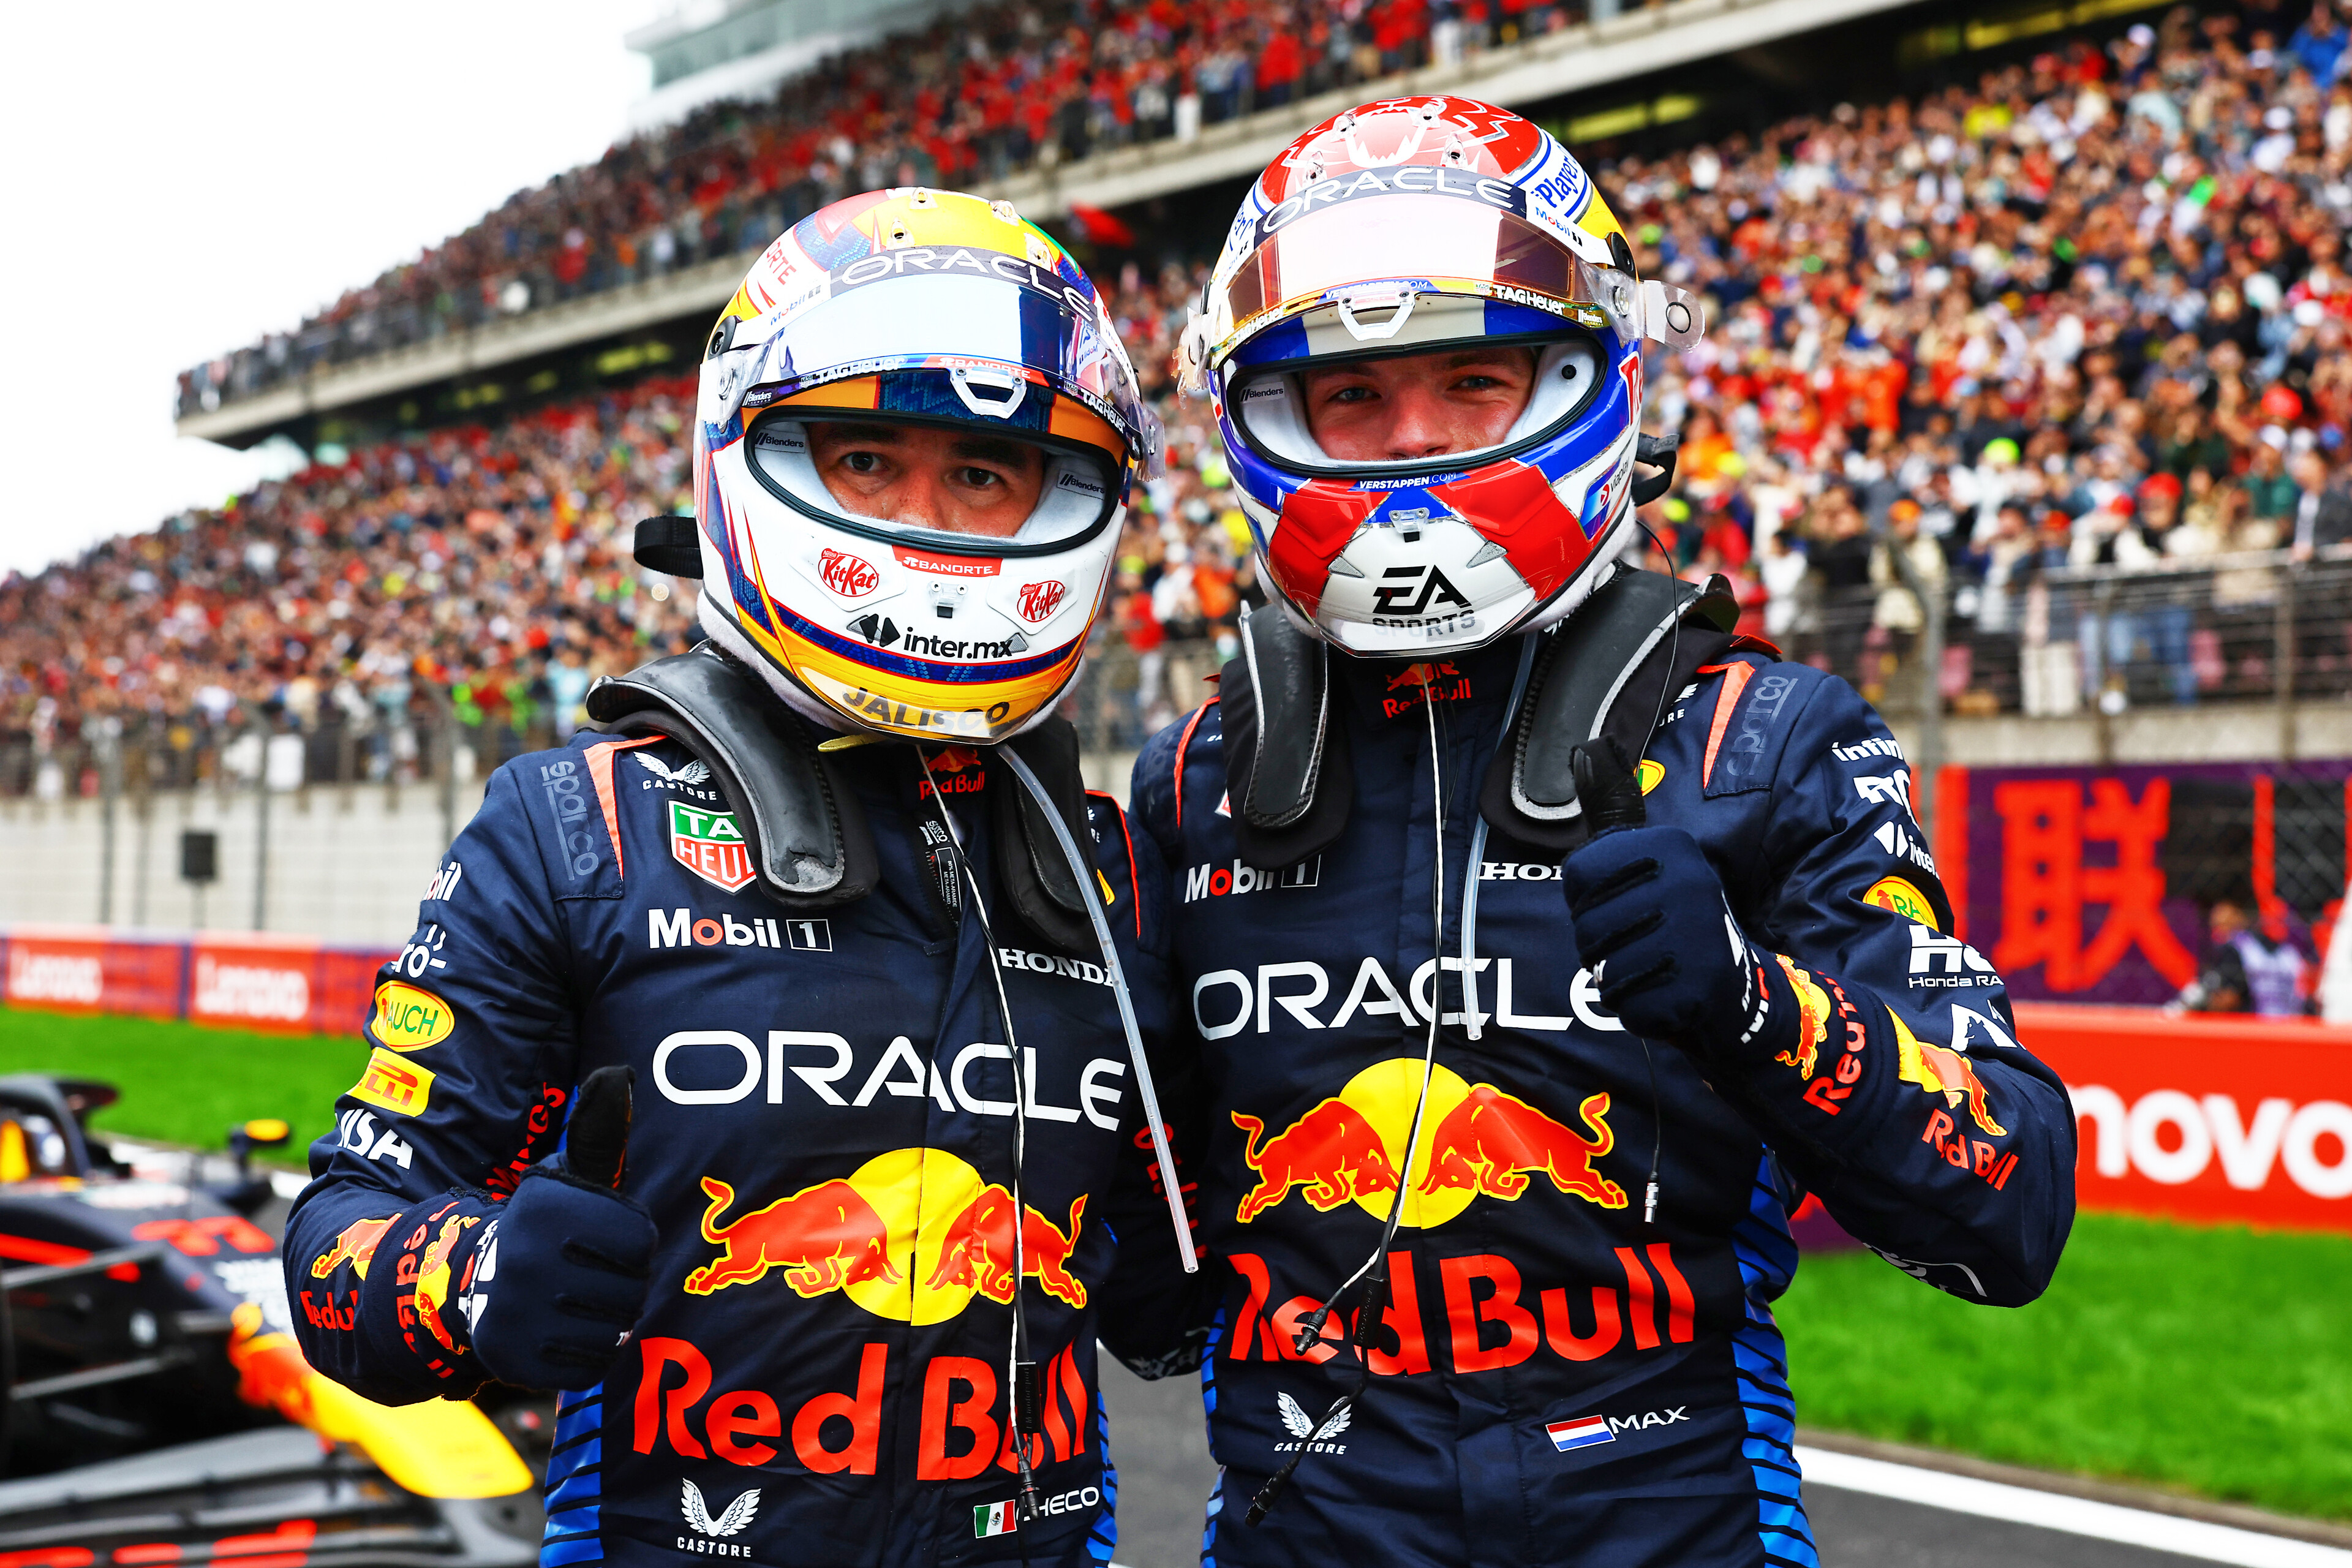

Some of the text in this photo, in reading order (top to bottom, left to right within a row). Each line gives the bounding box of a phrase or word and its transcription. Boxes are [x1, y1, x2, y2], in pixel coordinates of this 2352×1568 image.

[1263, 167, 1514, 233] ORACLE
[1536, 206, 1570, 236] Mobil
[766, 241, 797, 285] ORTE
[842, 248, 1094, 322] ORACLE
[771, 294, 805, 326] Mobil
[748, 391, 772, 403] Blenders
[1250, 388, 1284, 398] Blenders
[766, 435, 804, 448] Blenders
[1071, 478, 1106, 494] Blenders
[1359, 472, 1457, 489] VERSTAPPEN.COM
[1610, 456, 1630, 493] viaplay
[919, 560, 993, 575] BANORTE
[1372, 564, 1472, 616] EA
[1372, 609, 1476, 637] SPORTS
[903, 627, 1013, 659] inter.mx
[842, 687, 1011, 735] JALISCO
[1726, 676, 1790, 777] sparco
[1831, 737, 1904, 762] infin
[642, 778, 717, 801] CASTORE
[954, 771, 986, 794] Bull
[543, 760, 600, 876] sparco
[679, 809, 742, 839] TA
[1992, 778, 2199, 993] 联
[648, 908, 782, 949] Mobil
[1909, 976, 1973, 989] Honda
[1193, 957, 1628, 1041] ORACLE
[652, 1030, 1126, 1132] ORACLE
[2063, 1083, 2352, 1200] novo
[1439, 1242, 1695, 1374] Bull
[633, 1336, 889, 1476] Red
[1608, 1405, 1691, 1436] MAX
[1273, 1442, 1348, 1456] CASTORE
[677, 1536, 752, 1558] CASTORE
